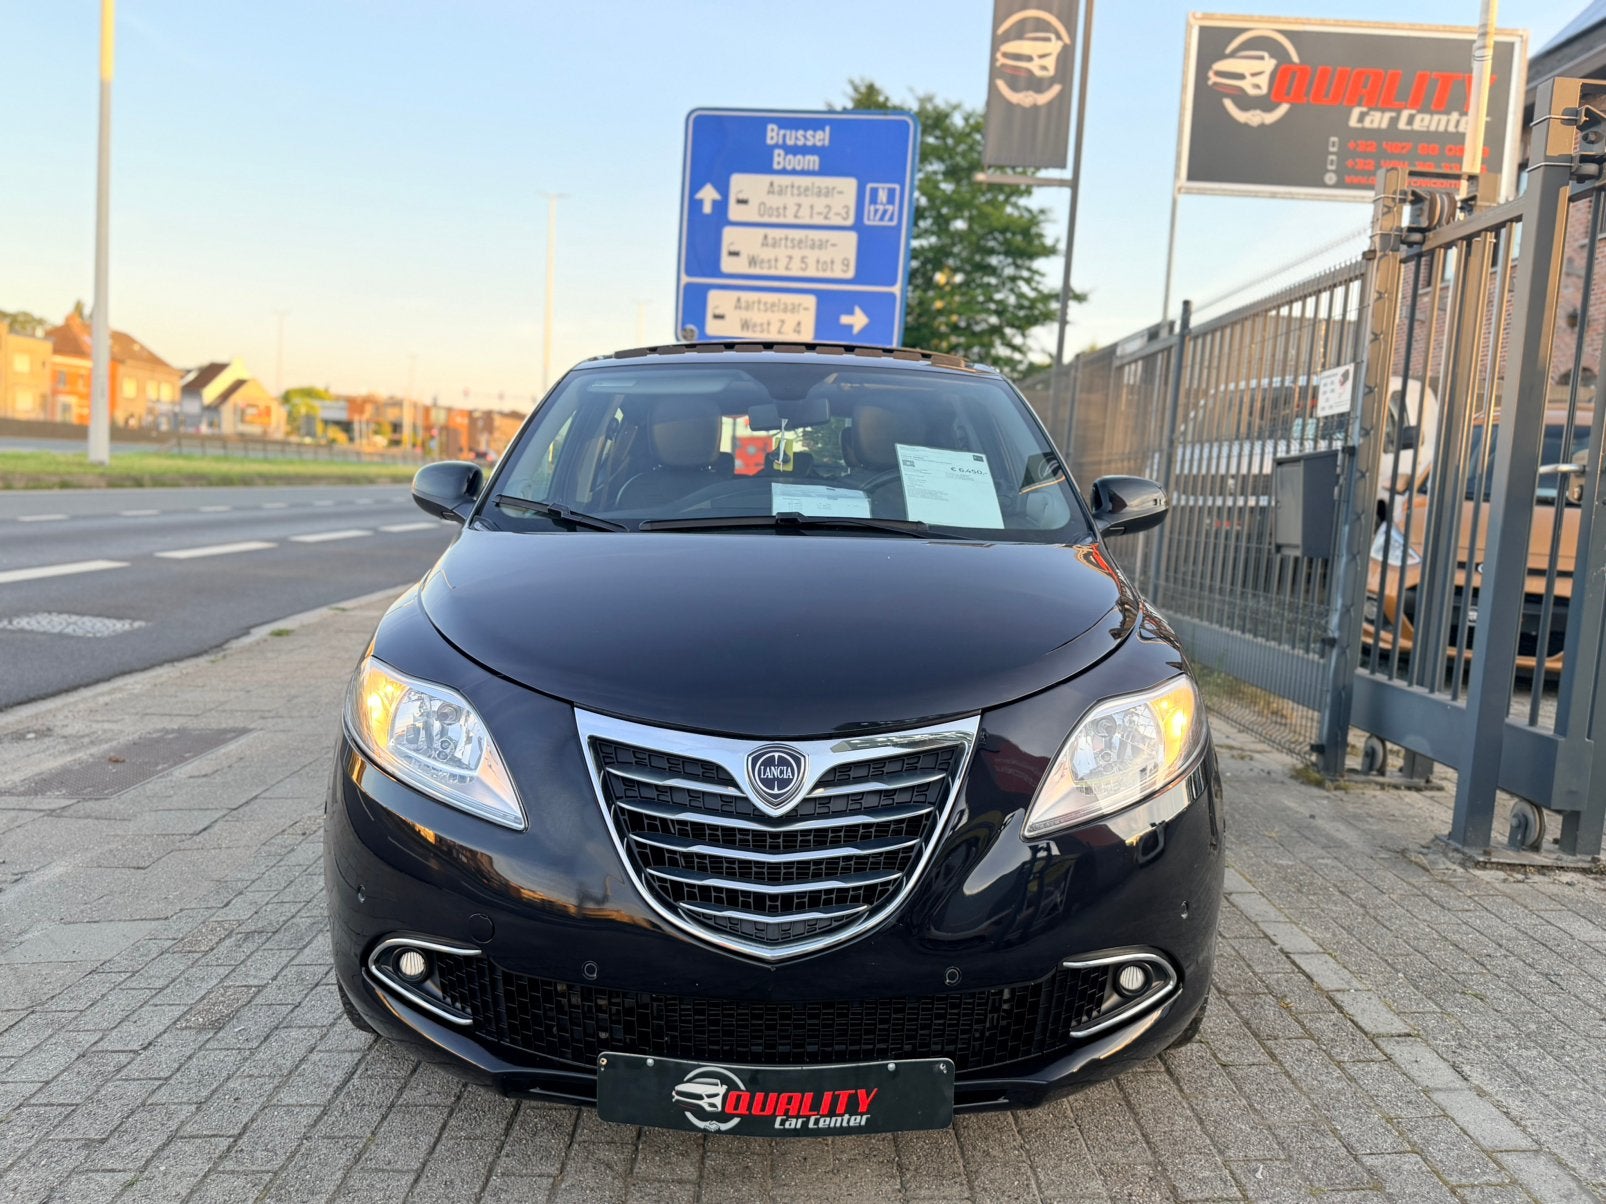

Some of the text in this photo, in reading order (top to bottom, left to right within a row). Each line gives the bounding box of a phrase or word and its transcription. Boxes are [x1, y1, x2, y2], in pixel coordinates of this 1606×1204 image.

[1348, 106, 1491, 133] Car Cente
[766, 123, 831, 146] Brussel
[772, 148, 820, 171] Boom
[767, 181, 844, 197] Aartselaar-
[877, 187, 889, 204] N
[757, 202, 788, 219] Oost
[868, 204, 894, 222] 177
[760, 234, 838, 250] Aartselaar-
[746, 254, 778, 271] West
[815, 257, 835, 273] tot
[840, 257, 850, 274] 9
[734, 297, 810, 314] Aartselaar-
[740, 317, 772, 334] West
[792, 320, 803, 336] 4
[760, 766, 793, 779] LANCIA
[724, 1087, 878, 1116] QUALITY
[774, 1113, 871, 1130] Car Center
